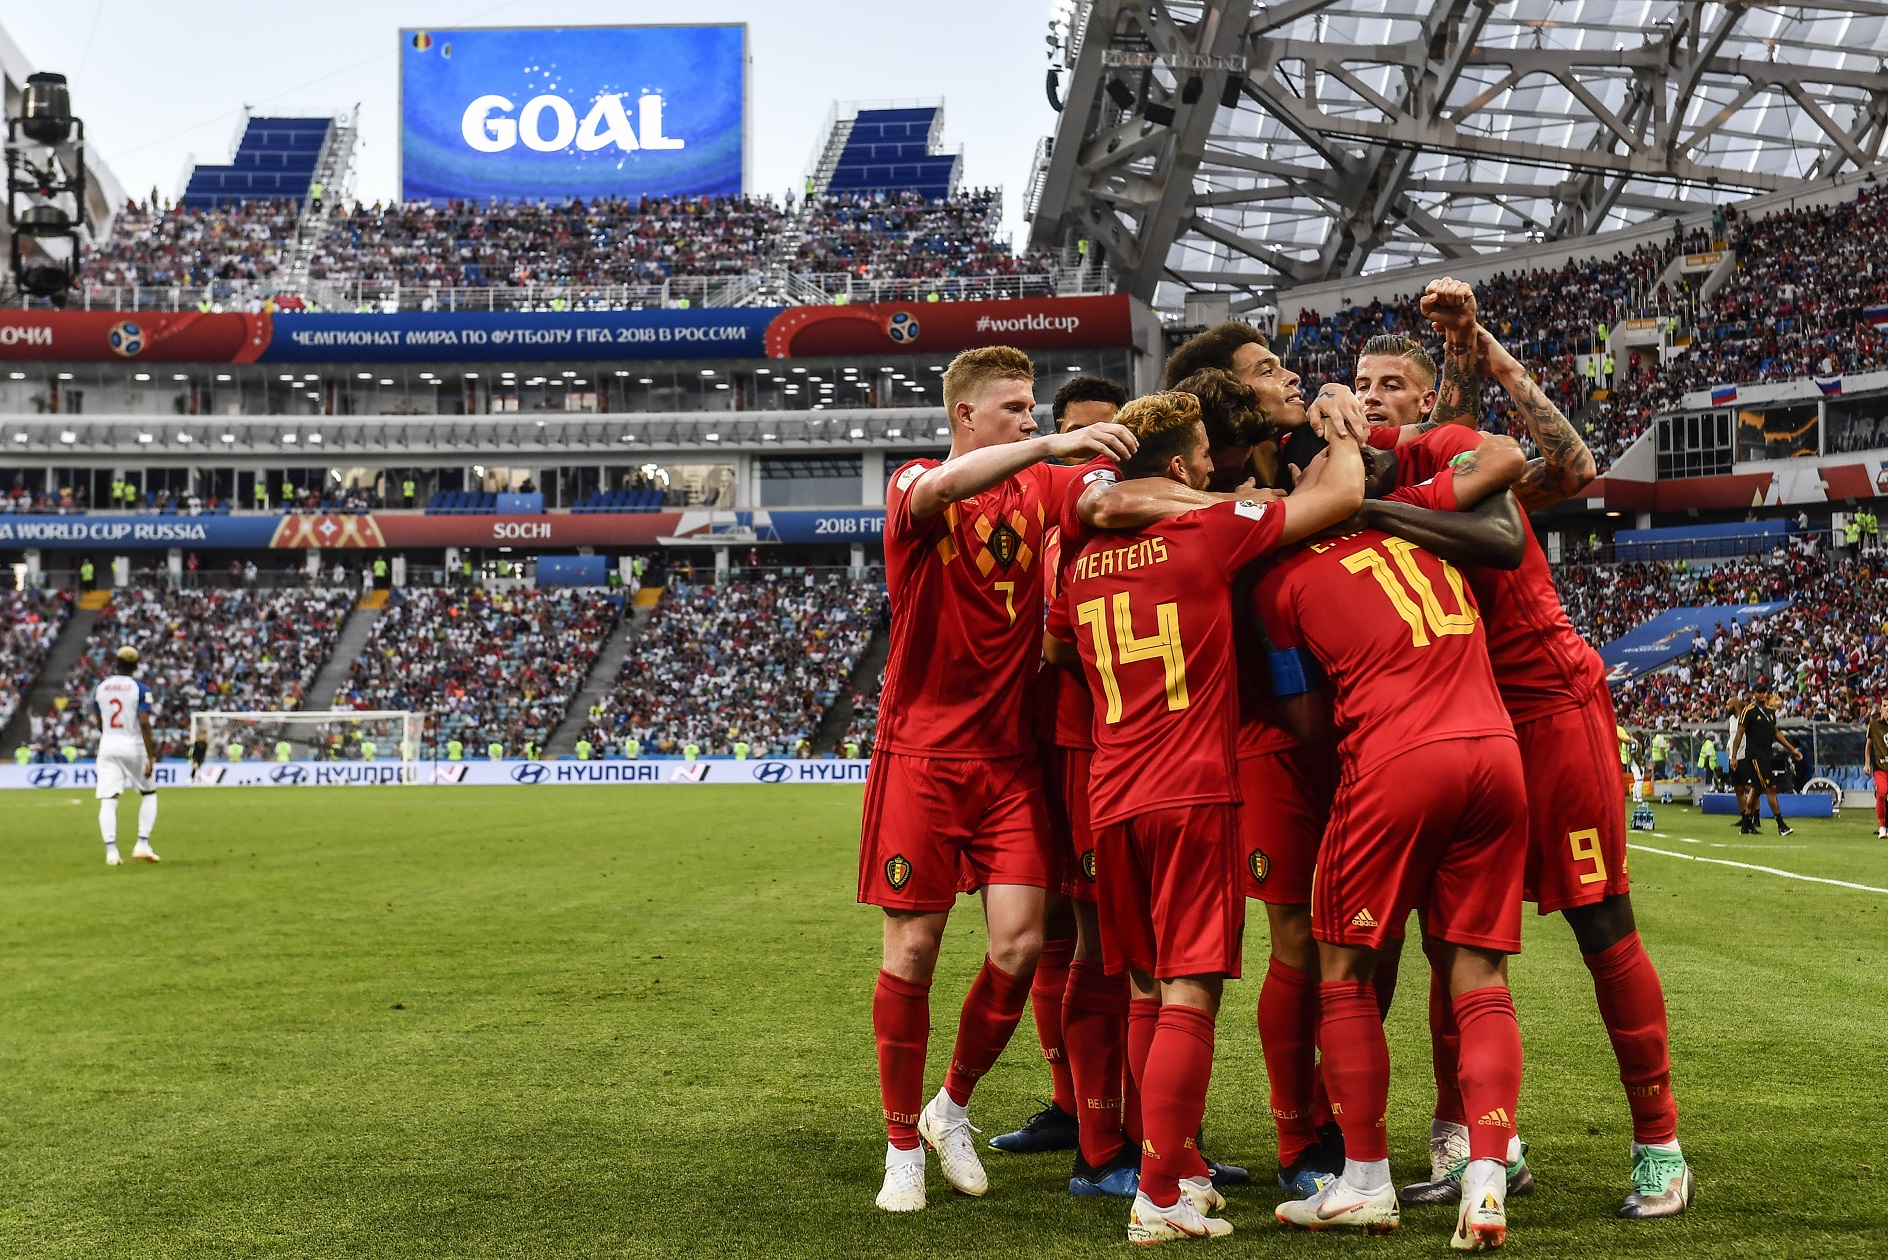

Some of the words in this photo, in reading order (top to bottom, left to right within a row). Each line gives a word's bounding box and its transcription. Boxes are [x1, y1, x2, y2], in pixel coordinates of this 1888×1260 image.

[461, 94, 685, 153] GOAL
[976, 313, 1080, 333] #worldcup
[0, 325, 53, 345] ОЧИ
[291, 330, 401, 346] ЧЕМПИОНАТ
[405, 330, 459, 346] МИРА
[461, 329, 488, 345] ПО
[491, 328, 572, 345] ФУТБОЛУ
[576, 328, 613, 343] FIFA
[616, 327, 656, 343] 2018
[674, 325, 747, 342] РОССИИ
[16, 523, 88, 540] WORLD
[90, 523, 132, 540] CUP
[133, 523, 206, 540] RUSSIA
[492, 522, 552, 539] SOCHI
[815, 517, 857, 534] 2018
[859, 516, 886, 533] FIF
[1072, 536, 1169, 584] MERTENS
[1338, 536, 1481, 648] 10
[994, 581, 1017, 629] 7
[1076, 590, 1190, 725] 14
[109, 697, 124, 729] 2
[74, 769, 176, 783] HYAI
[557, 765, 659, 781] HYUNDAI
[800, 764, 870, 780] HYUN
[1568, 827, 1608, 885] 9
[1351, 919, 1379, 927] adidas
[1477, 1119, 1512, 1129] adidas
